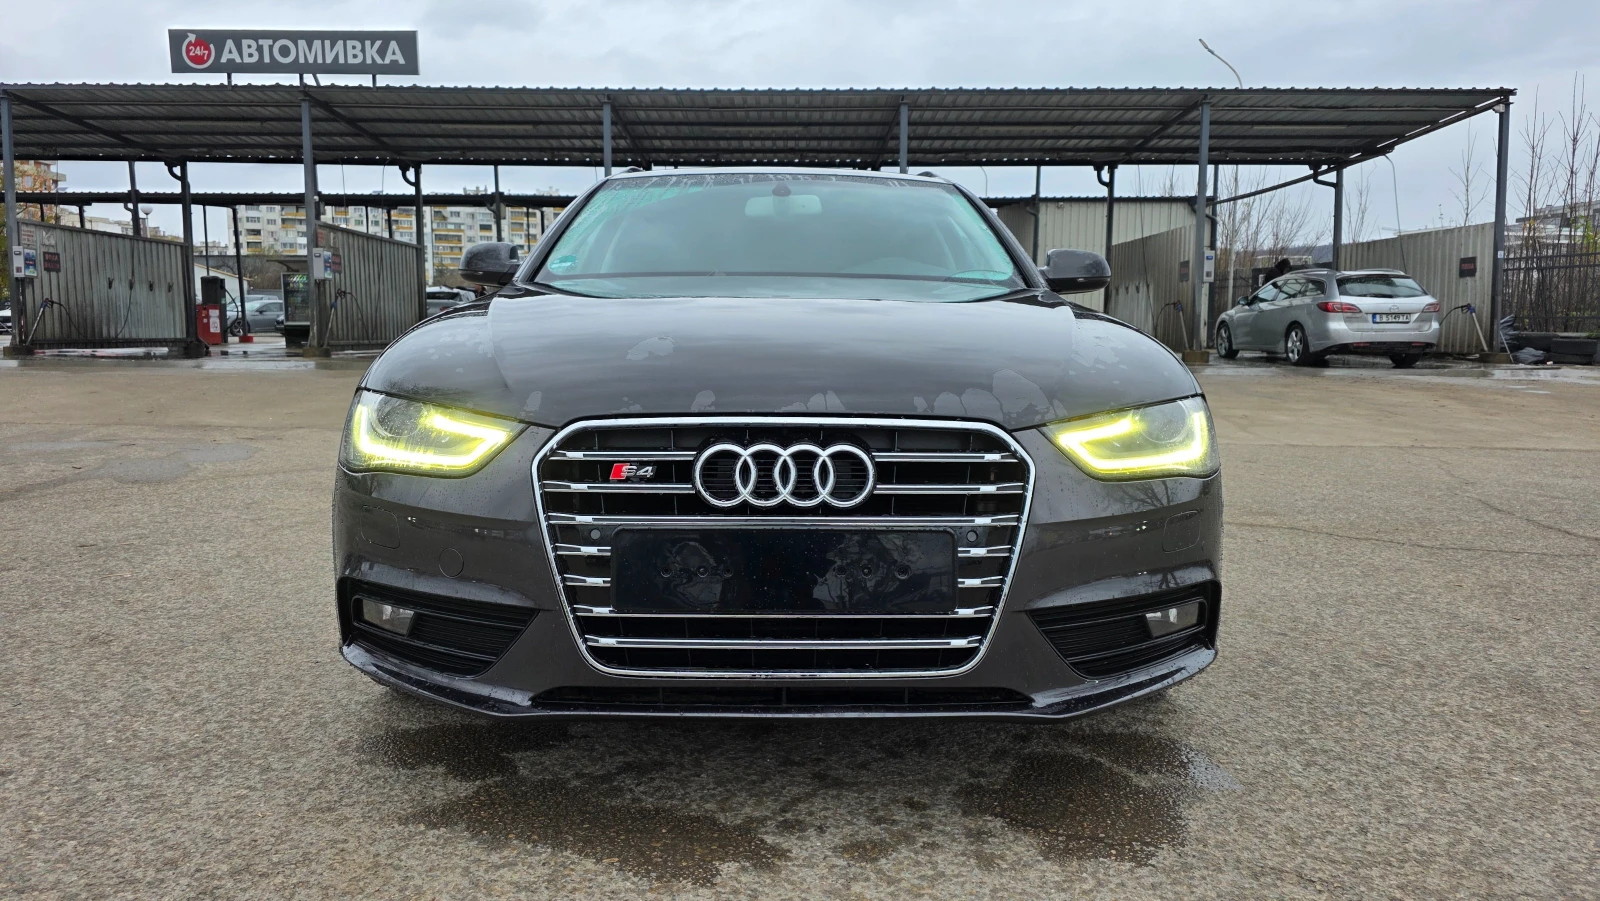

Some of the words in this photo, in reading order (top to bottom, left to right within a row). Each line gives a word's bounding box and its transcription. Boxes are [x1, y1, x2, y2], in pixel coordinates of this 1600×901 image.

[189, 45, 209, 60] 24/7
[220, 39, 406, 65] АВТОМИВКА
[620, 465, 654, 478] S4
